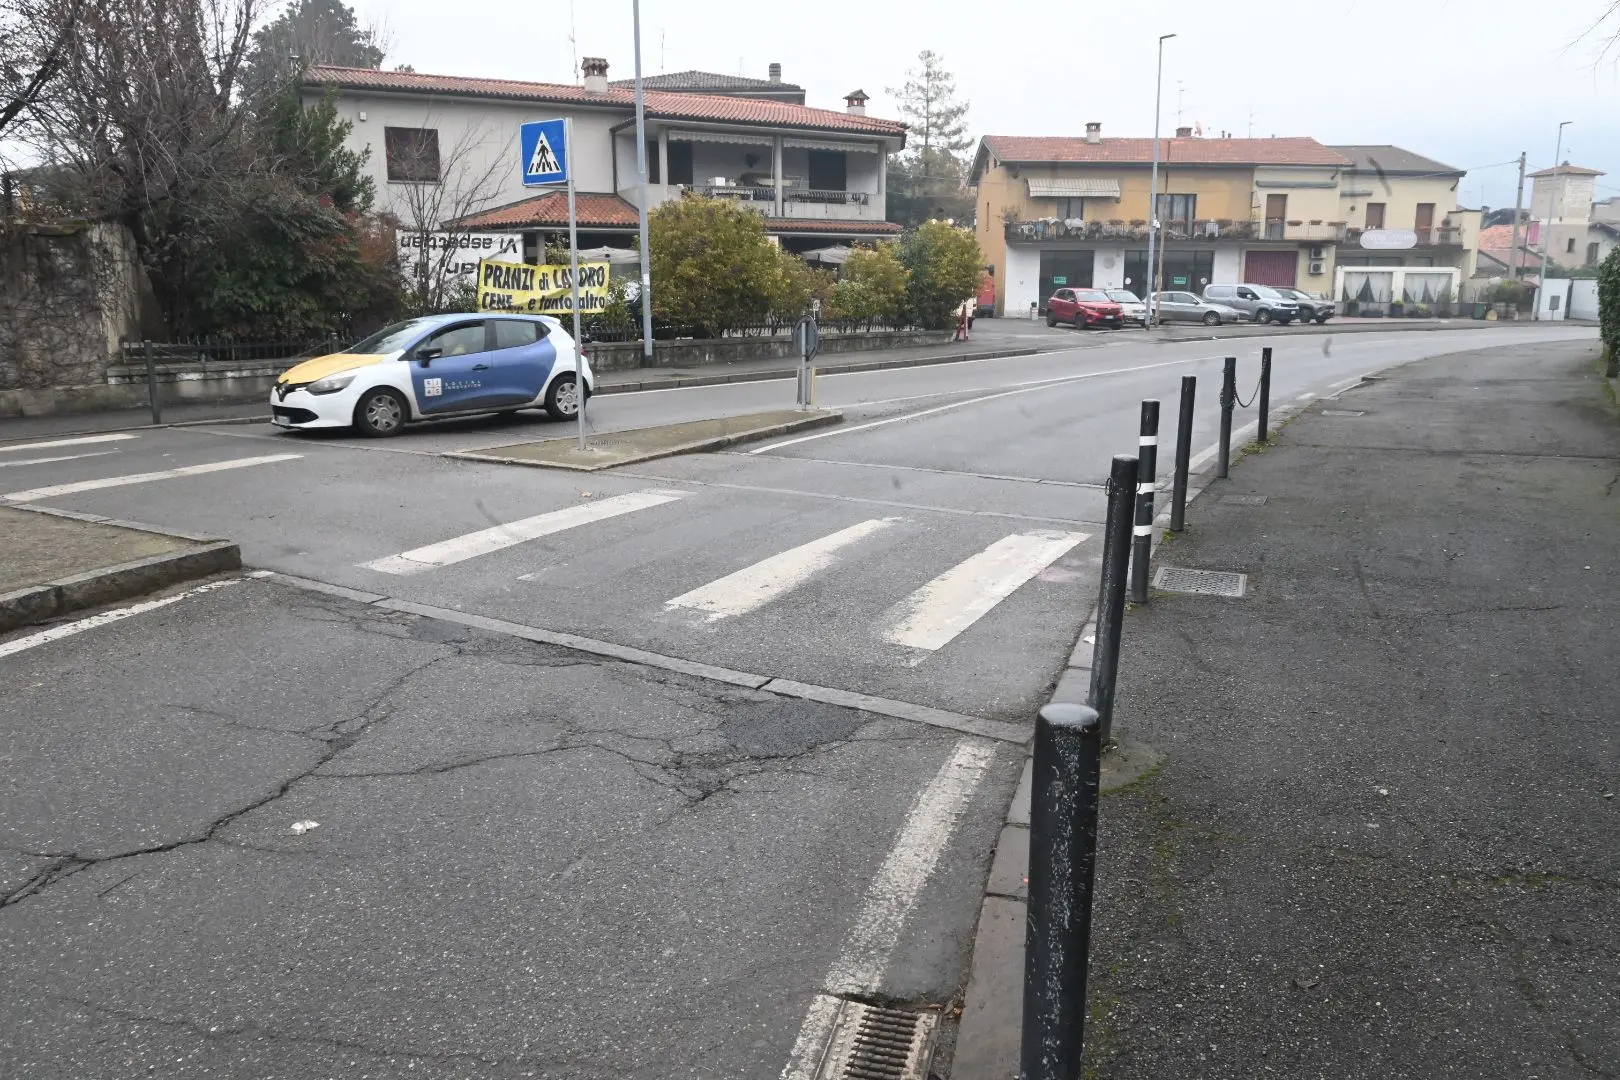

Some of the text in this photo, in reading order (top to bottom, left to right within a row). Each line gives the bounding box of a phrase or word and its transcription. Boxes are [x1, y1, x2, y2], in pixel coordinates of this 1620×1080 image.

[484, 263, 535, 291] PRANZI
[539, 272, 549, 291] di
[528, 298, 536, 310] e
[539, 295, 572, 310] tanto
[578, 290, 605, 309] altro
